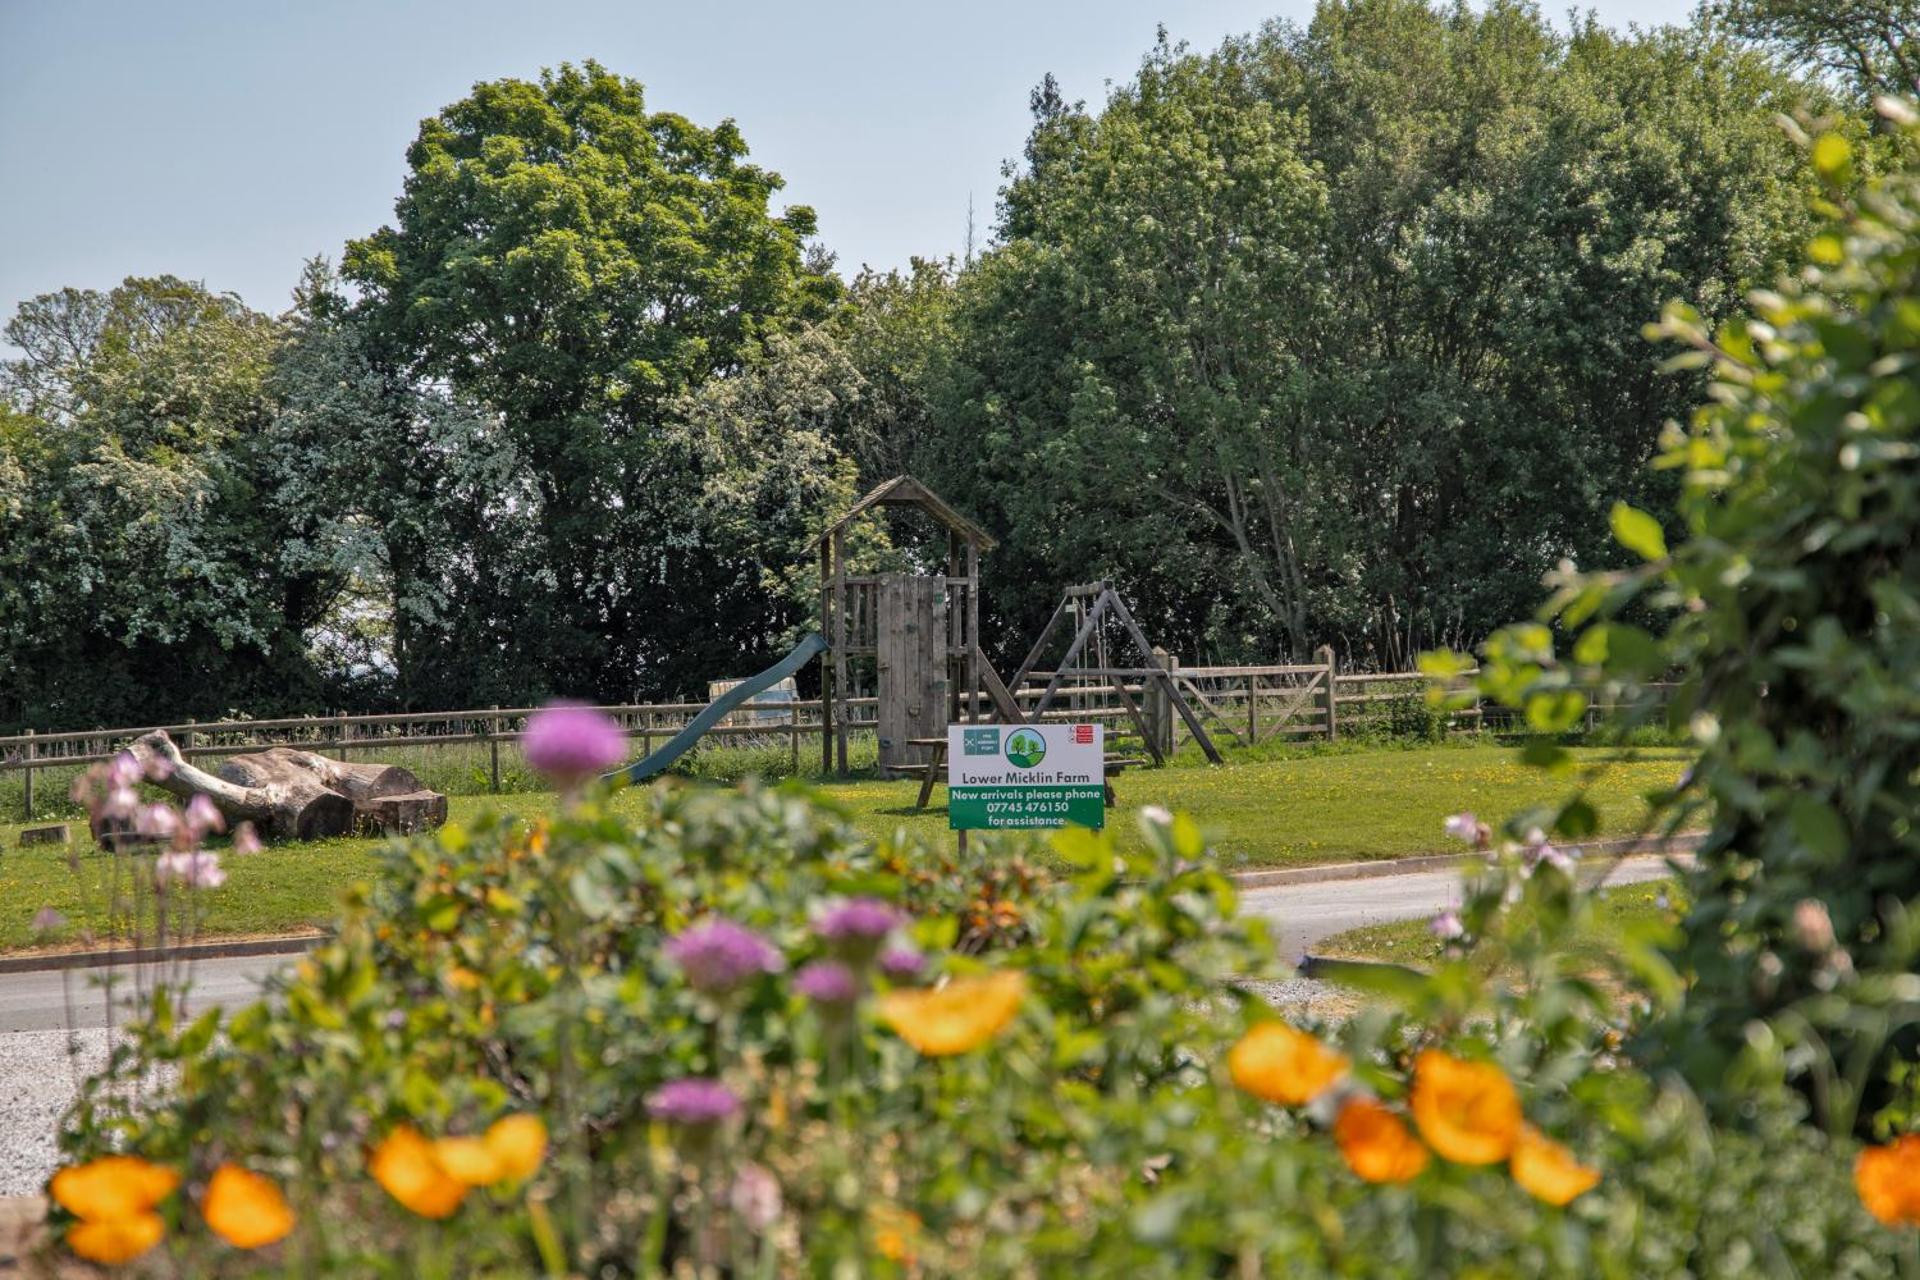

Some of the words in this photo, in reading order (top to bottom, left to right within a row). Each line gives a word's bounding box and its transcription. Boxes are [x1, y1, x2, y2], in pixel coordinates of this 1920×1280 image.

[962, 772, 1002, 784] Lower
[1005, 772, 1053, 784] Micklin
[1056, 771, 1090, 783] Farm
[952, 790, 978, 800] New
[980, 789, 1023, 800] arrivals
[1026, 789, 1062, 801] please
[1065, 788, 1101, 801] phone
[986, 802, 1023, 813] 07745
[1025, 802, 1069, 812] 476150
[988, 816, 1004, 826] for
